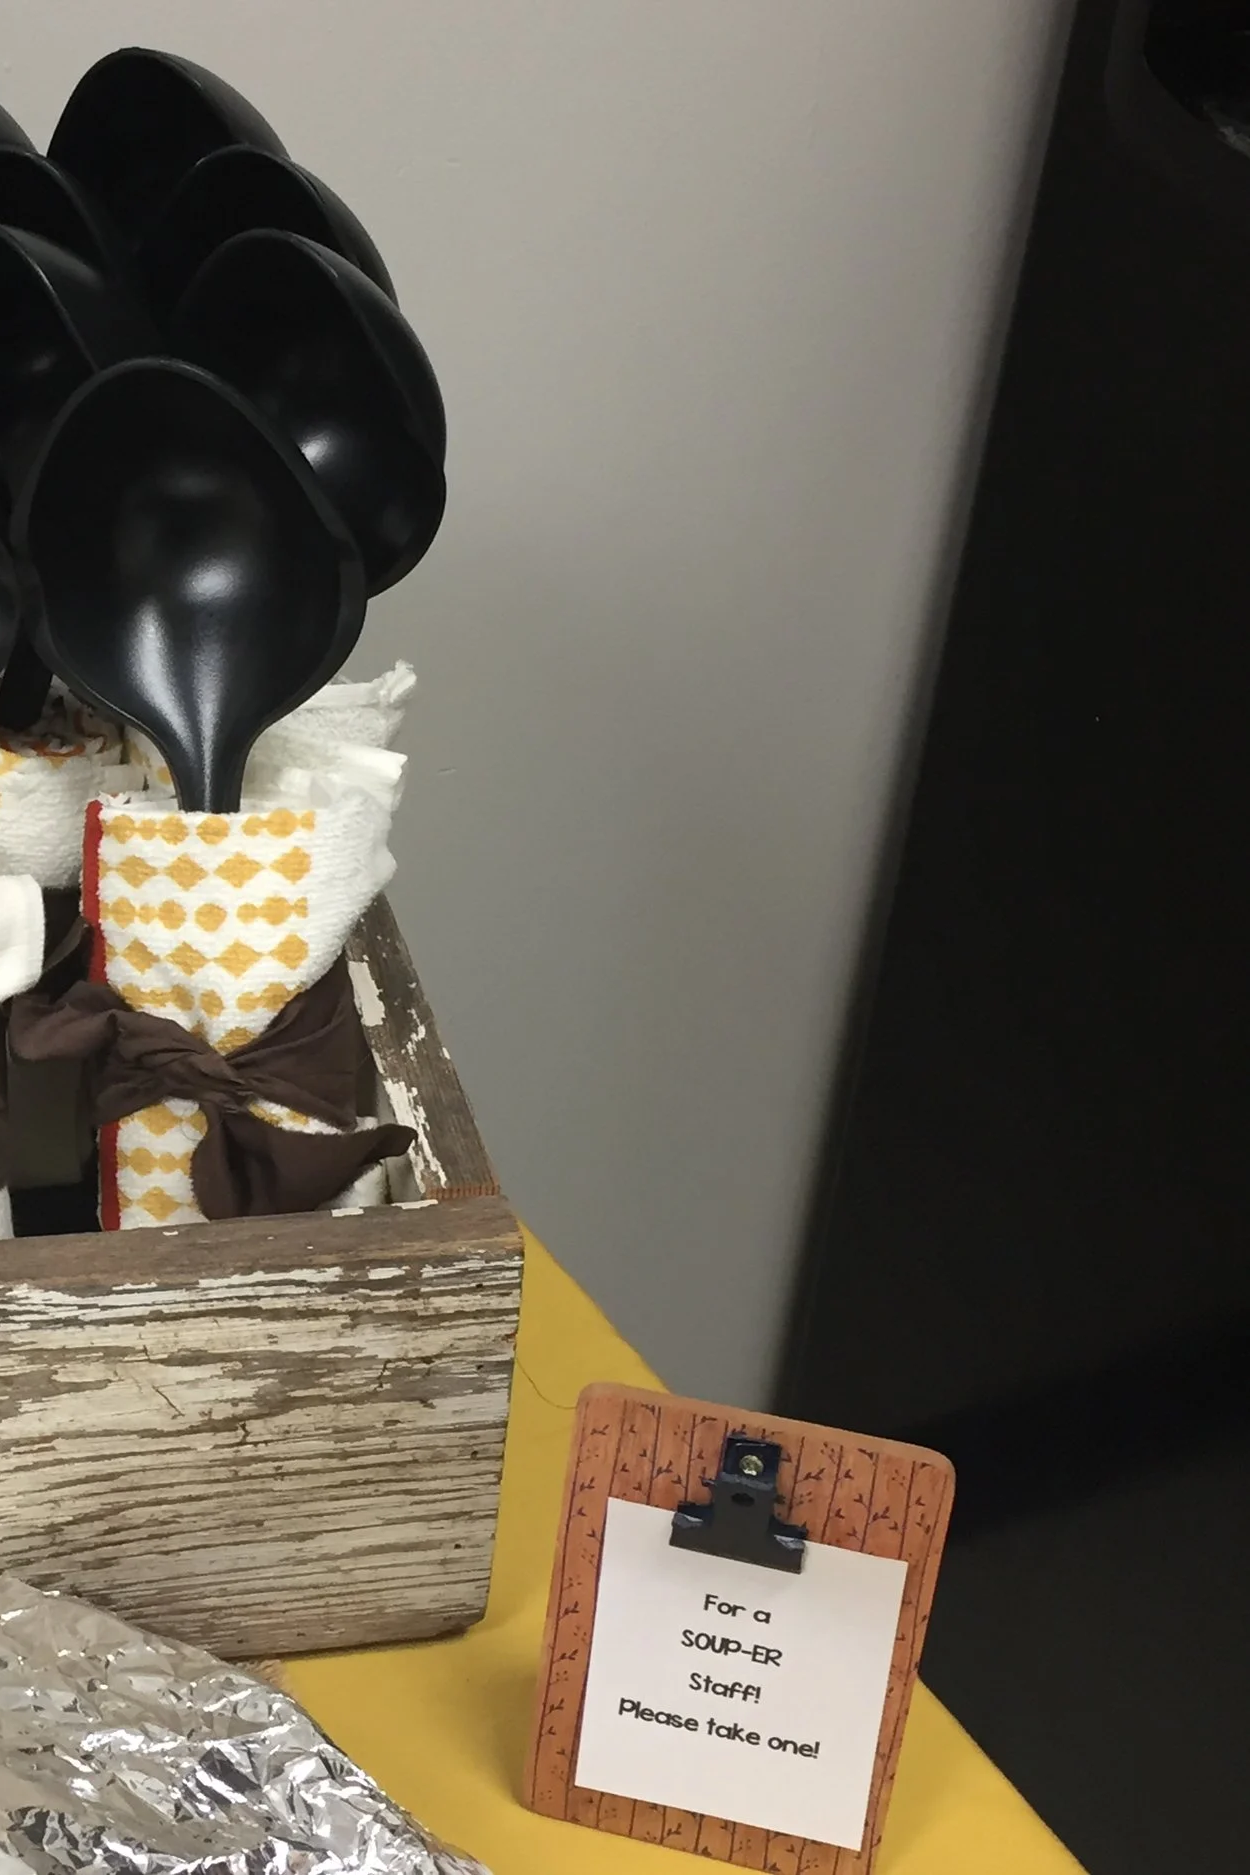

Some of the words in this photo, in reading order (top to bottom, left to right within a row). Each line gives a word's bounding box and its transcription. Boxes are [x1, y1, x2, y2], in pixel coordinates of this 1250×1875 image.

[703, 1593, 747, 1617] For
[753, 1609, 772, 1625] a
[681, 1629, 783, 1667] SOUP-ER
[689, 1672, 762, 1704] Staff!
[618, 1697, 699, 1732] Please
[706, 1717, 761, 1746] take
[767, 1735, 821, 1759] one!
